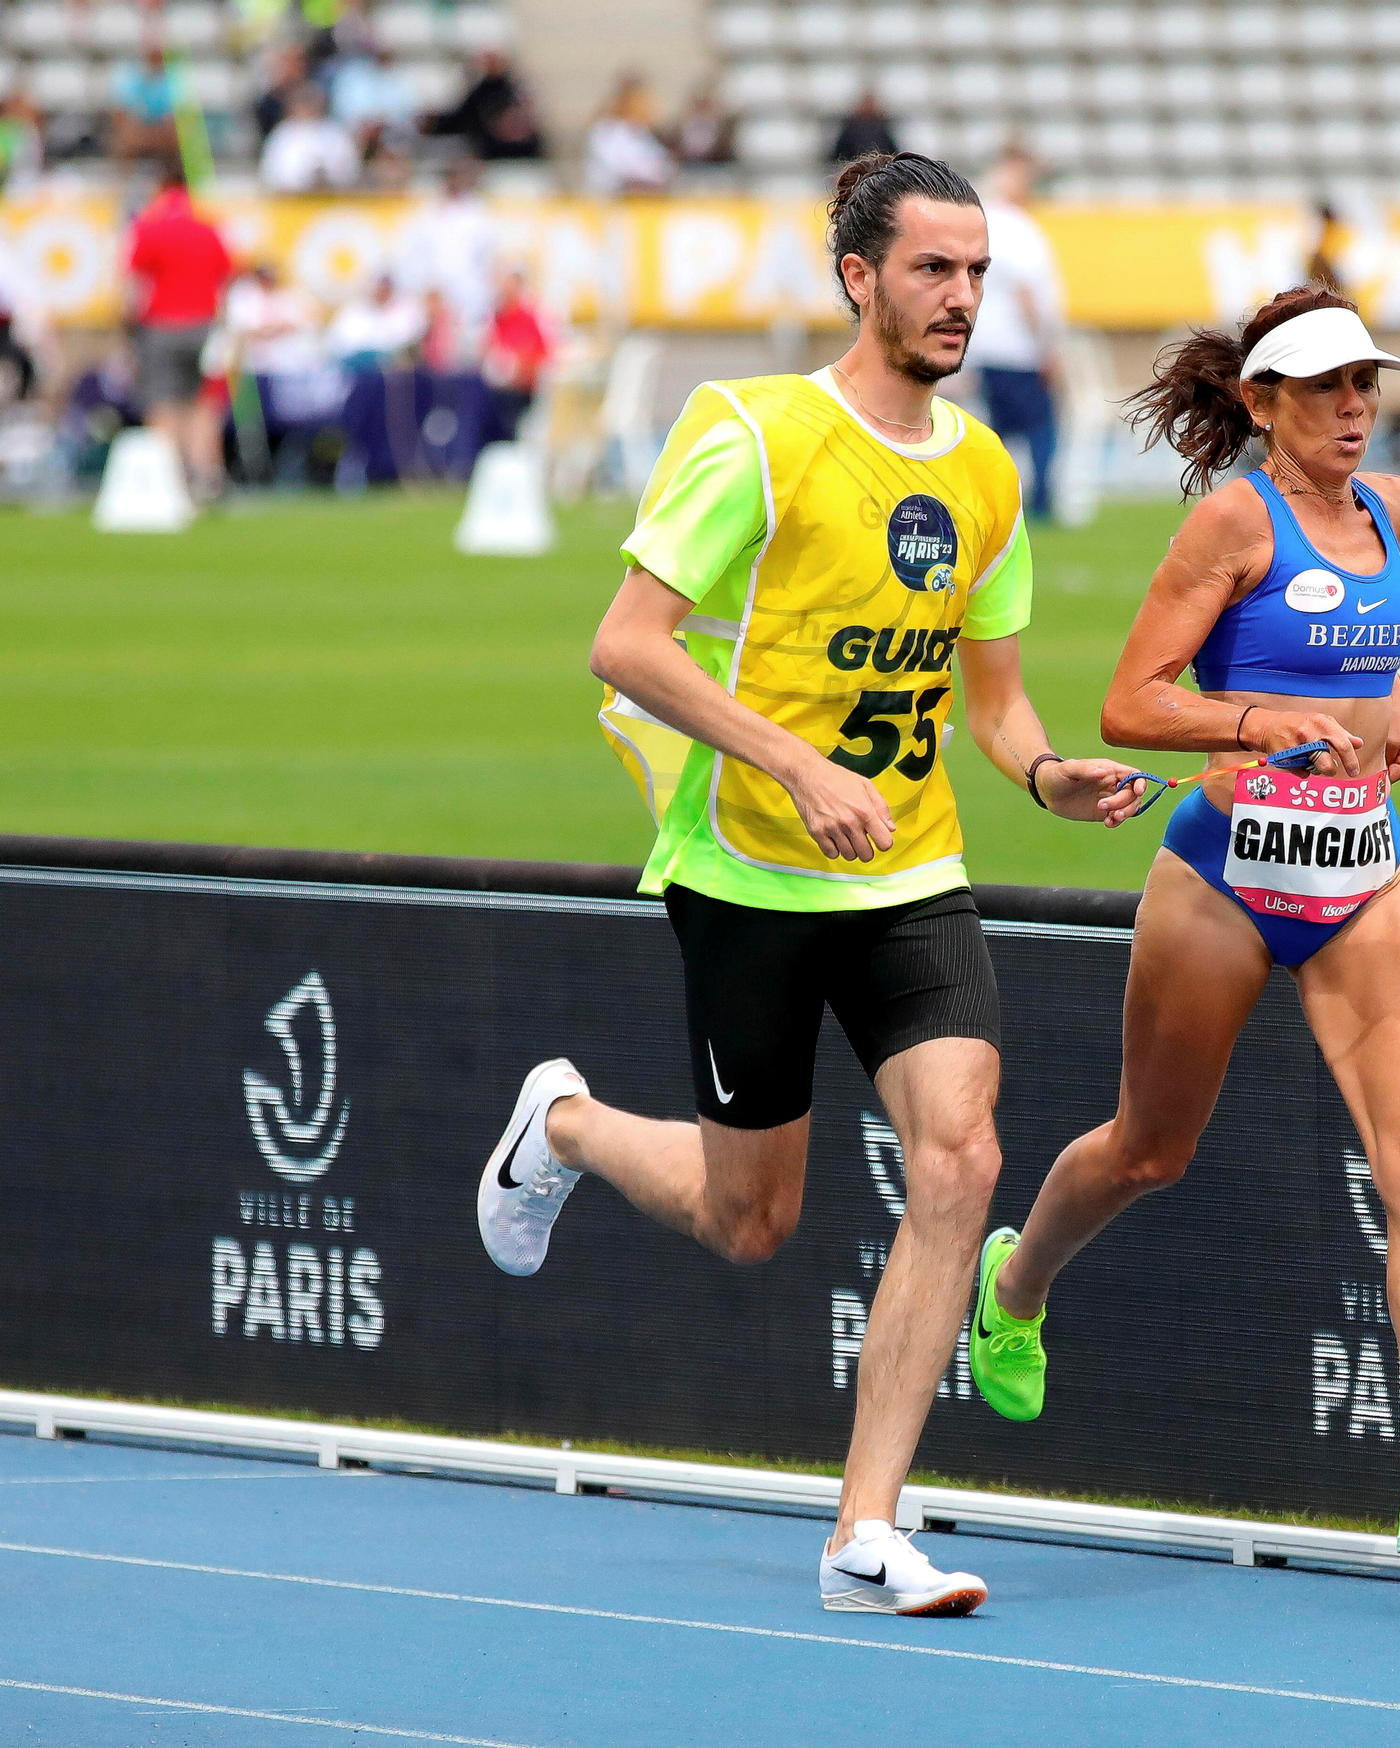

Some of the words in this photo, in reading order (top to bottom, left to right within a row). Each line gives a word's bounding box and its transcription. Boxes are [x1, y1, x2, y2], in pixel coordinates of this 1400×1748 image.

[900, 510, 928, 521] Athletics
[897, 541, 940, 564] PARIS
[826, 687, 952, 781] 55
[1233, 818, 1391, 868] GANGLOFF
[1264, 895, 1305, 915] Uber
[239, 1192, 313, 1229] VILLE
[211, 1238, 385, 1351] PARIS
